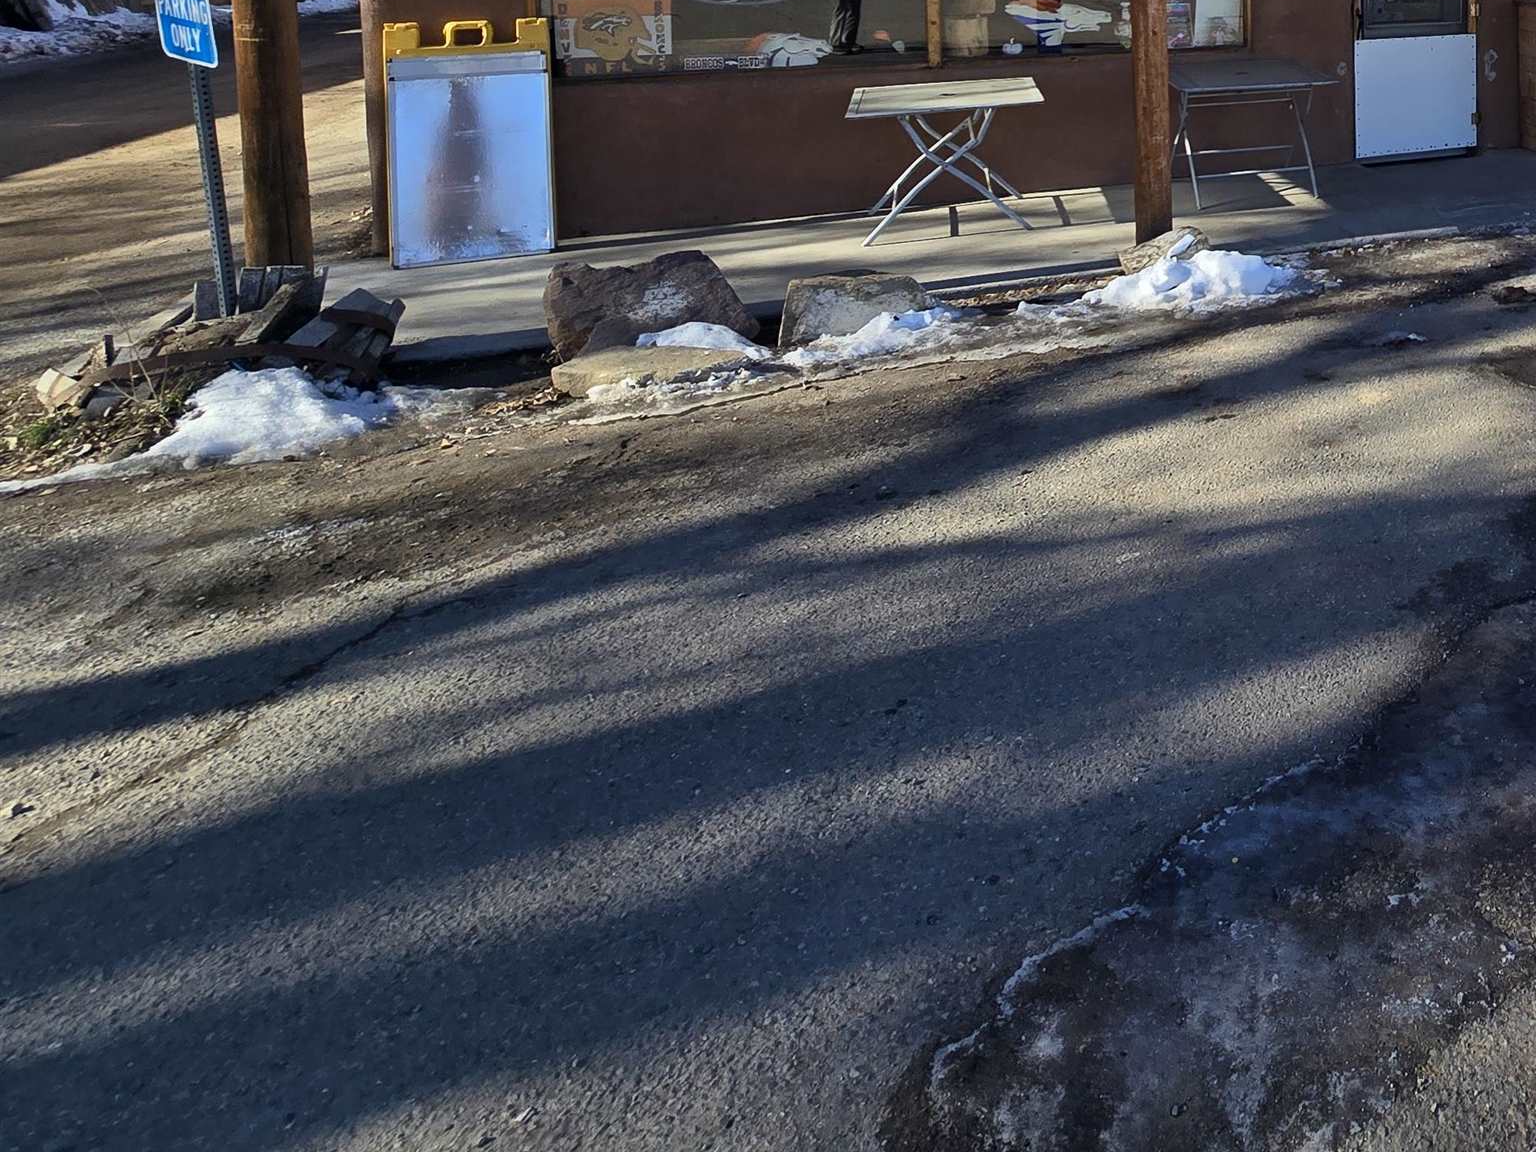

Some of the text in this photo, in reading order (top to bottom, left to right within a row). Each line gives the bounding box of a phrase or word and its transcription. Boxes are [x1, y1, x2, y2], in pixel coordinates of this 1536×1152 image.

[169, 23, 201, 53] ONLY
[585, 62, 633, 74] NFL
[684, 57, 725, 70] BRONCOS
